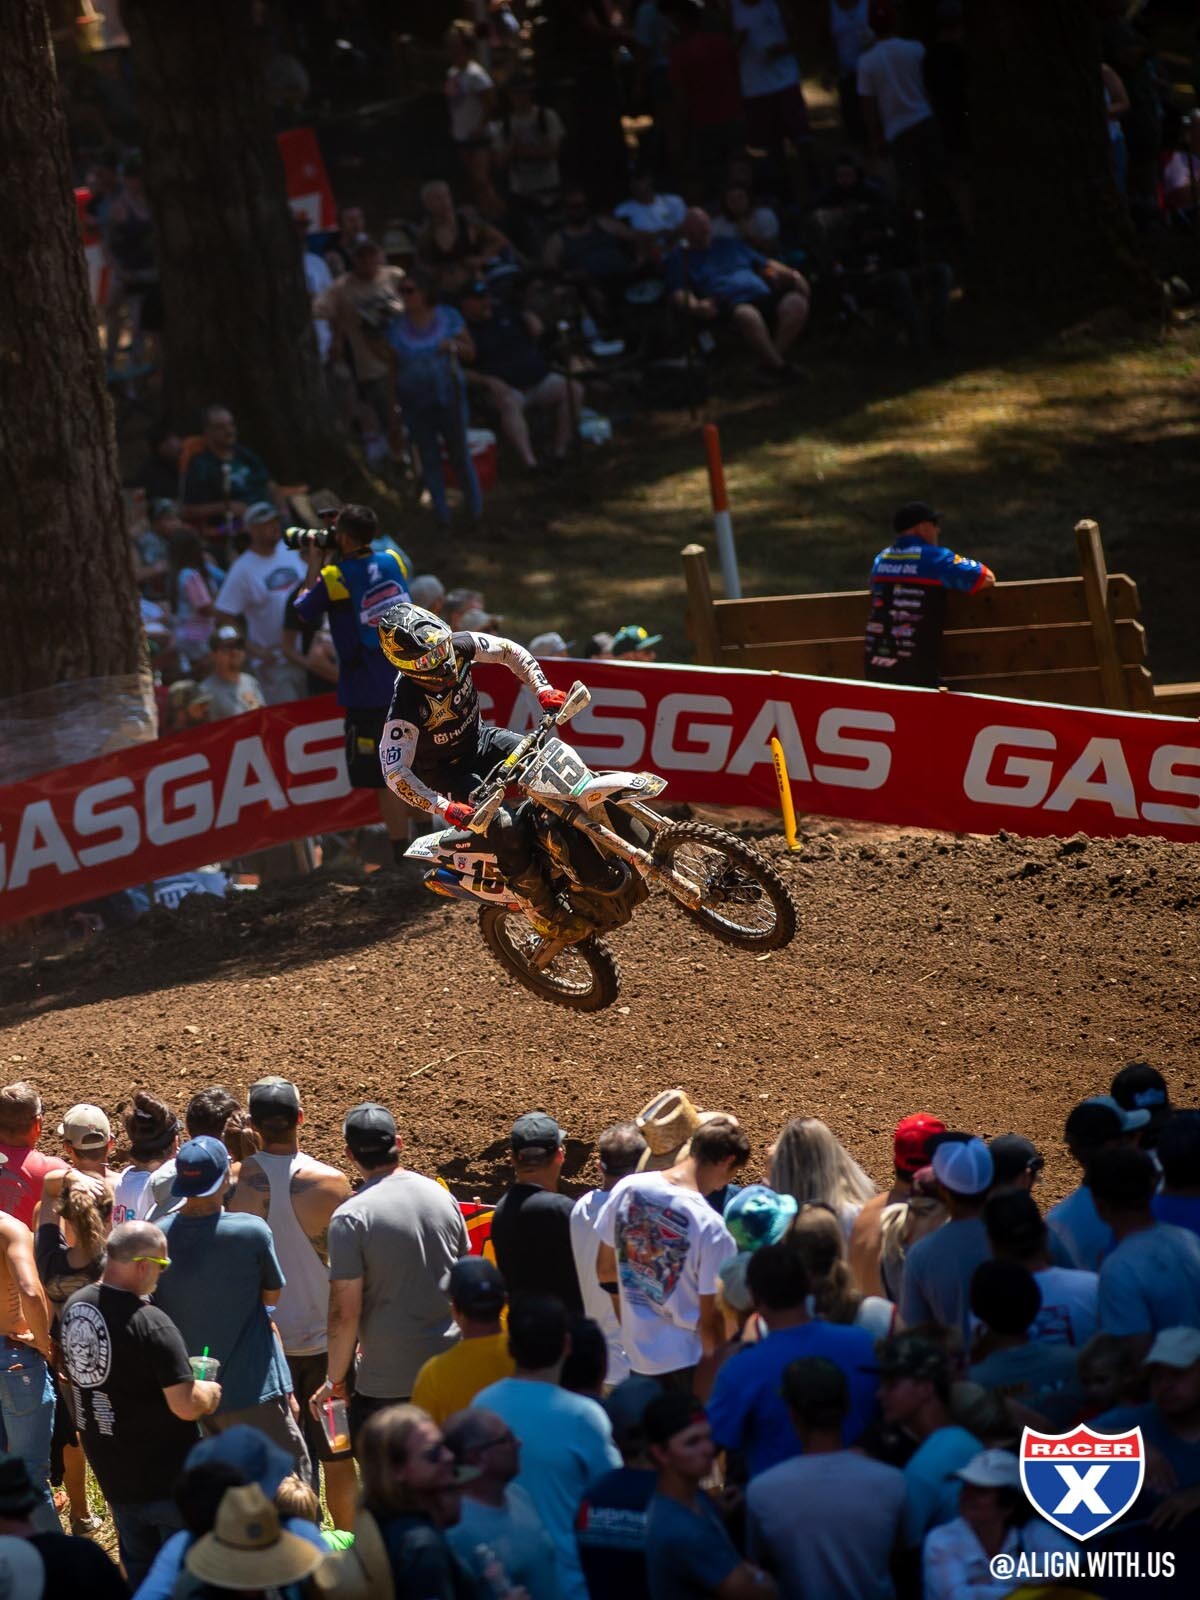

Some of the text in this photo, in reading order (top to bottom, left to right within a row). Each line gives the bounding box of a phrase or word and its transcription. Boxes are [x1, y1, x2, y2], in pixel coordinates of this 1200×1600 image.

[540, 747, 585, 795] 15
[963, 724, 1200, 827] GAS
[410, 849, 430, 857] DUNLOP
[471, 859, 505, 895] 15
